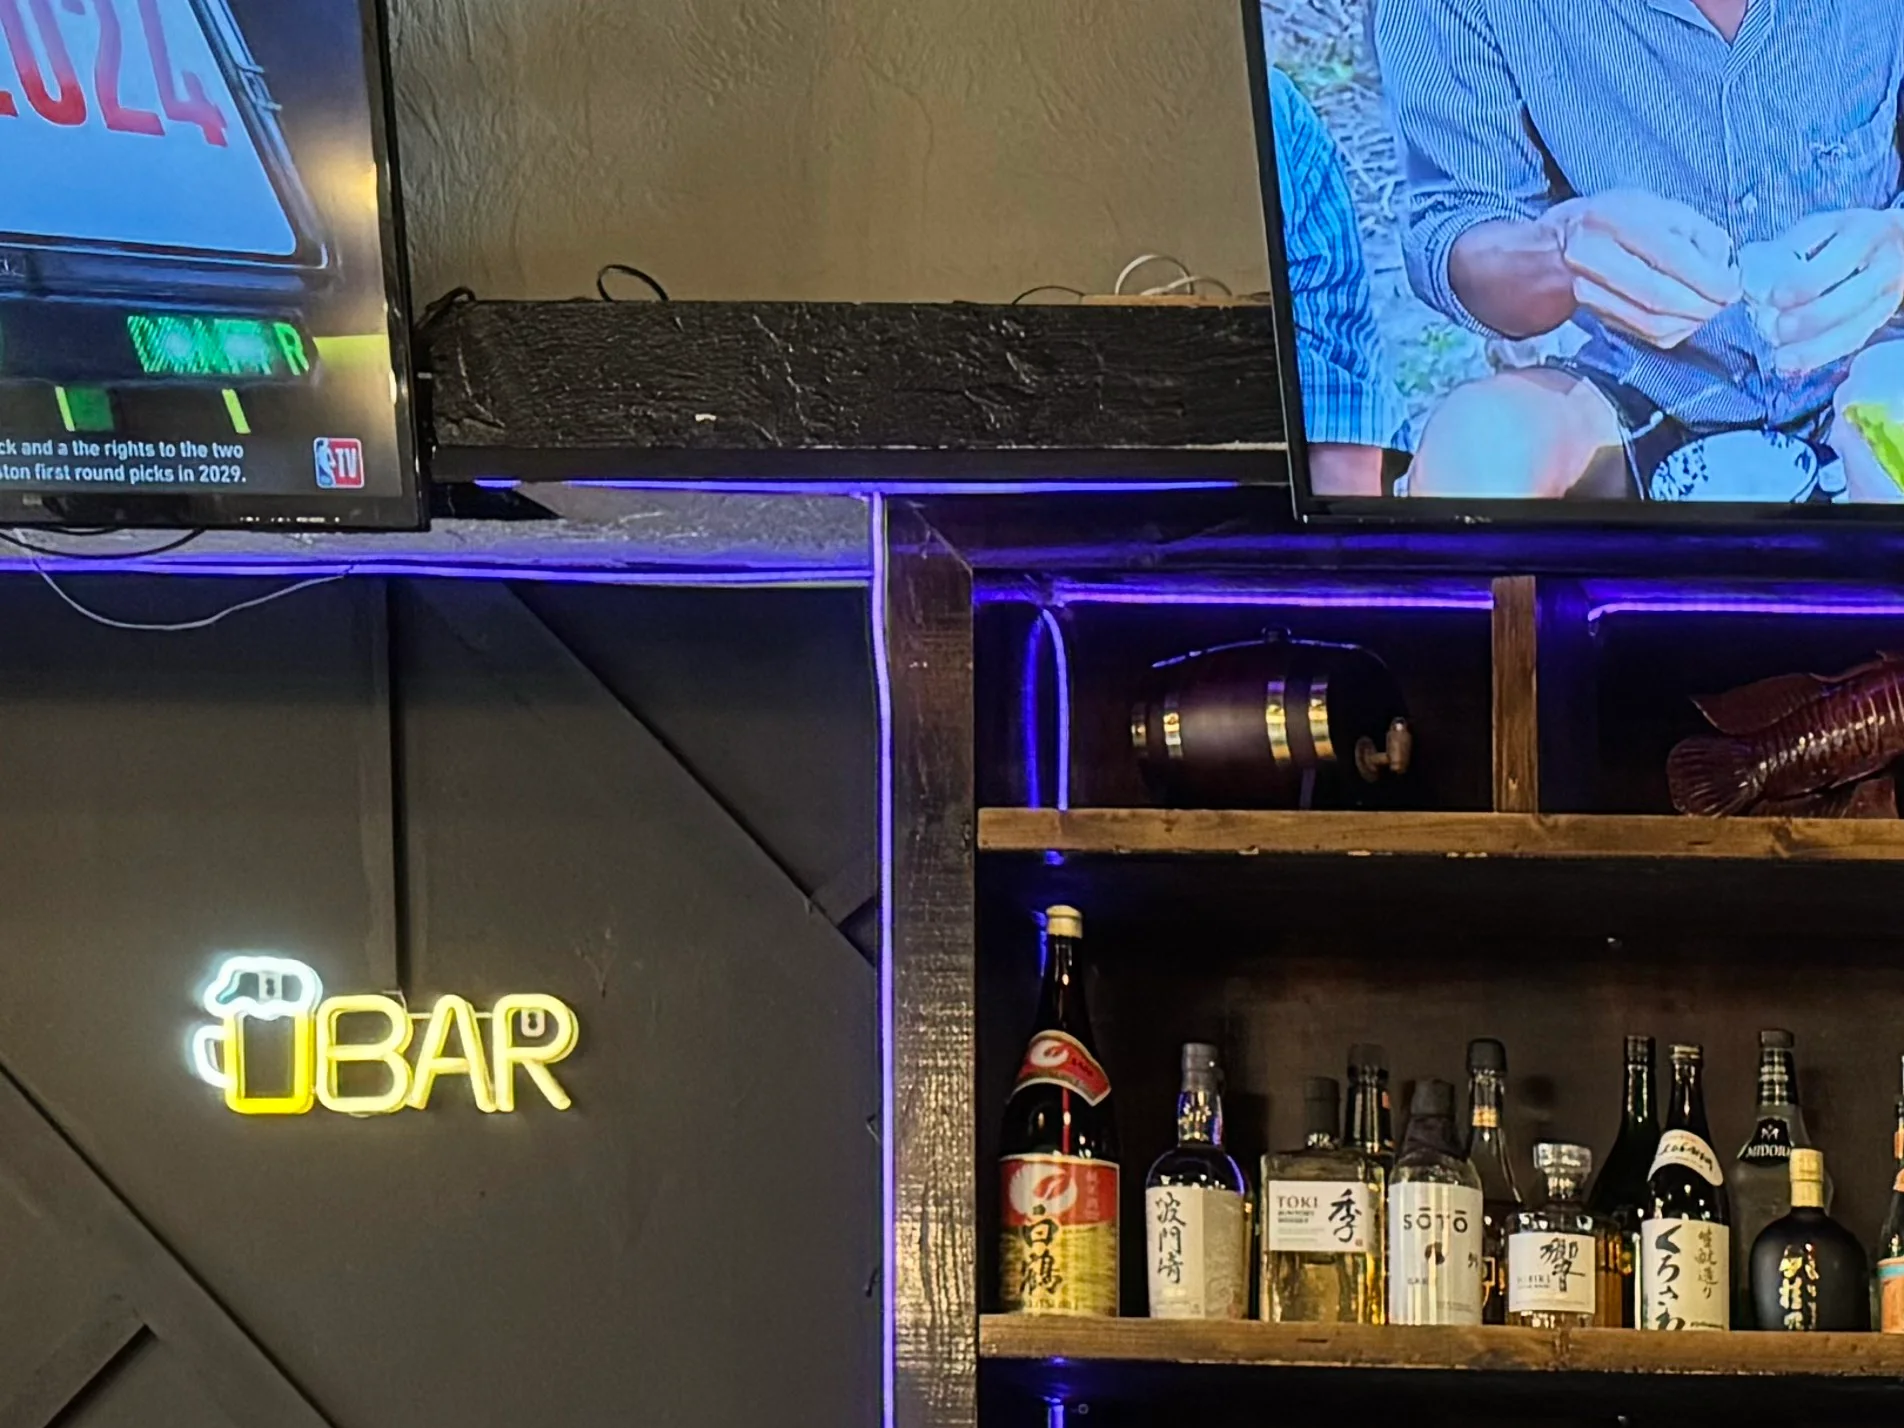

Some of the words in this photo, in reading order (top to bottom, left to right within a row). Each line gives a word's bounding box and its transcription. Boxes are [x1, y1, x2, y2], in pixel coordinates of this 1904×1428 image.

[0, 0, 228, 147] 024
[21, 439, 54, 456] and
[57, 442, 69, 456] a
[72, 439, 101, 457] the
[104, 439, 156, 460] rights
[159, 441, 177, 458] to
[180, 440, 209, 458] the
[212, 442, 245, 459] two
[0, 463, 31, 481] ton
[34, 462, 71, 481] first
[74, 464, 126, 482] round
[129, 464, 175, 485] picks
[178, 464, 195, 482] in
[198, 464, 247, 483] 2029.
[316, 994, 579, 1115] BAR
[1276, 1195, 1320, 1210] TOKI
